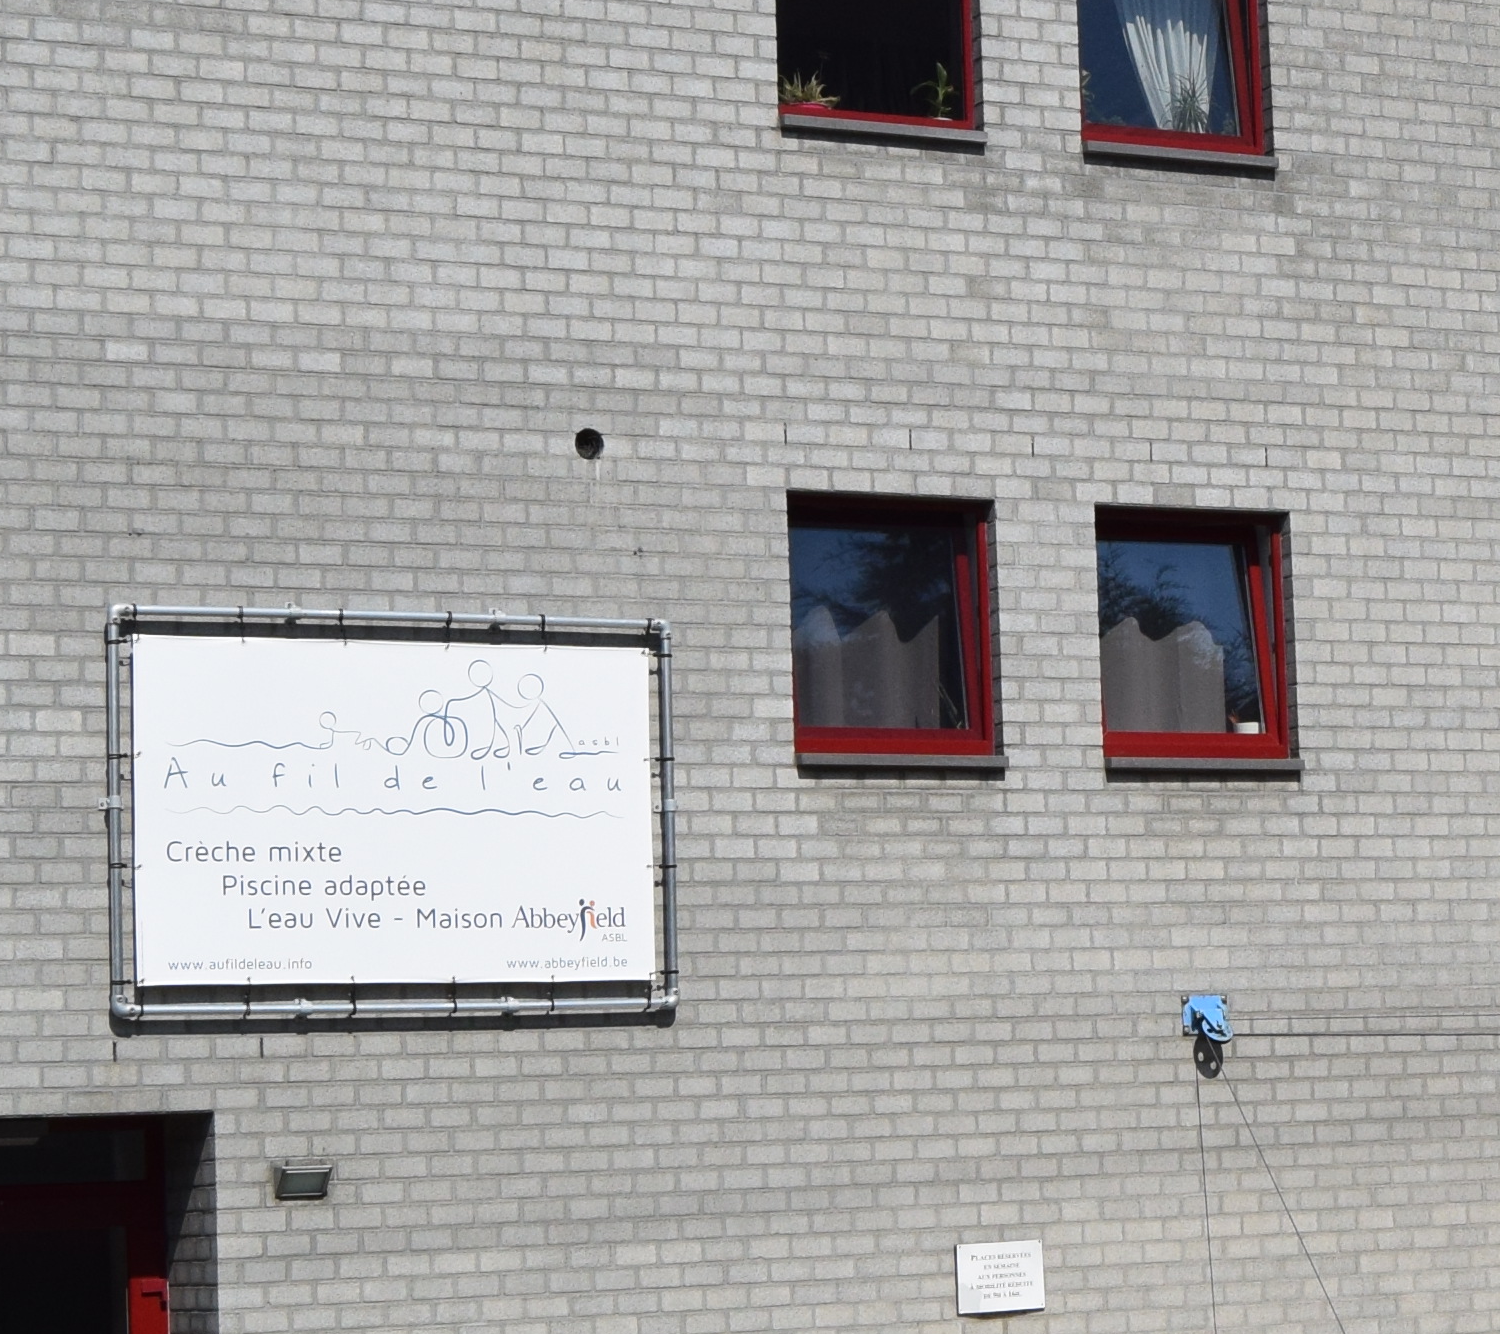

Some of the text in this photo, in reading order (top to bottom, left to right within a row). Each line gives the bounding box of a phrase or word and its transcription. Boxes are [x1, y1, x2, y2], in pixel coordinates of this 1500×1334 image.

[577, 736, 620, 747] asbl
[163, 756, 622, 792] Au fil de l'eau
[165, 840, 343, 863] Crèche mixte
[222, 874, 427, 901] Piscine adaptée
[247, 907, 314, 930] L'eau
[325, 907, 382, 930] Vive
[415, 907, 504, 930] Maison
[510, 898, 627, 942] Abbeyfield
[601, 933, 628, 943] ASBL
[167, 957, 313, 971] www.aufildeleau.info
[506, 956, 628, 971] www.abbeyfield.be
